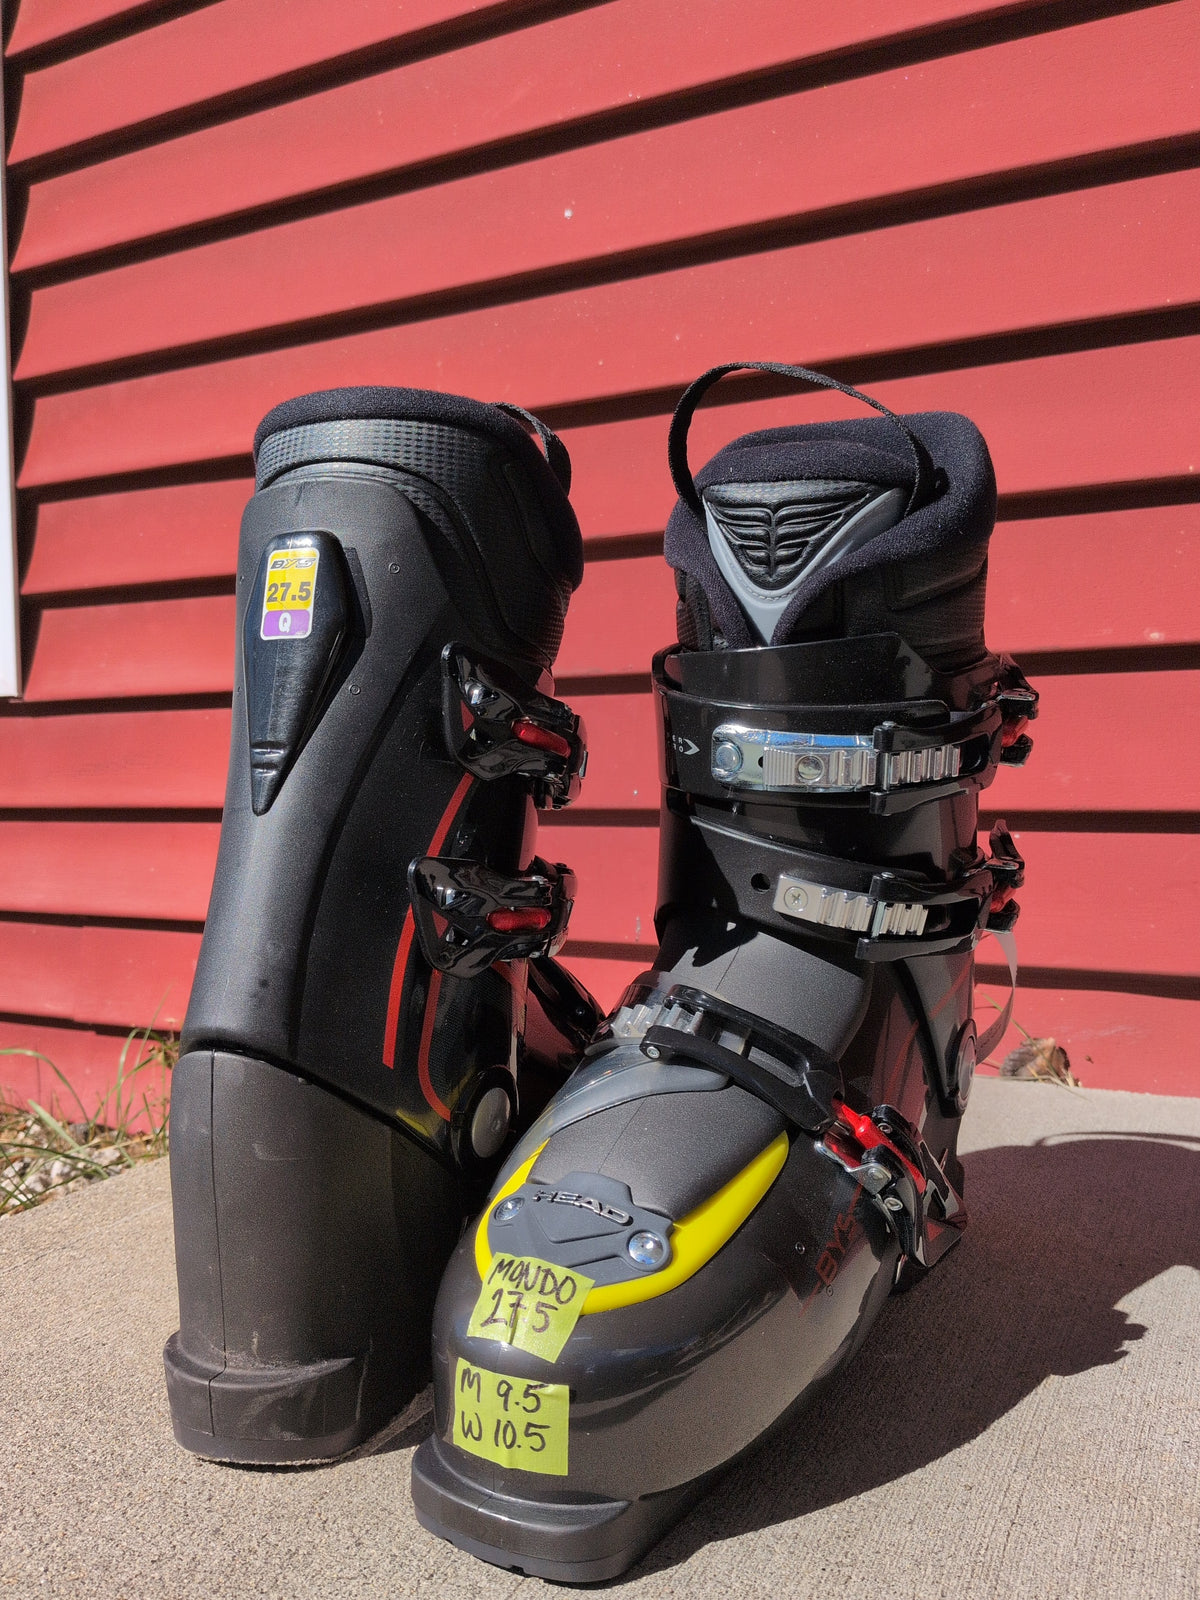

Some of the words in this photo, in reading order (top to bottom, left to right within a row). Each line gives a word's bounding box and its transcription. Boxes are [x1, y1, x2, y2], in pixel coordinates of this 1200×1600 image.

[270, 558, 316, 570] BYS
[266, 582, 312, 602] 27.5
[278, 612, 292, 634] Q
[532, 1189, 631, 1225] HEAD
[487, 1258, 577, 1305] MONDO
[460, 1367, 481, 1403] M
[496, 1379, 548, 1413] 9.5
[461, 1412, 483, 1442] W
[494, 1418, 551, 1452] 10.5
